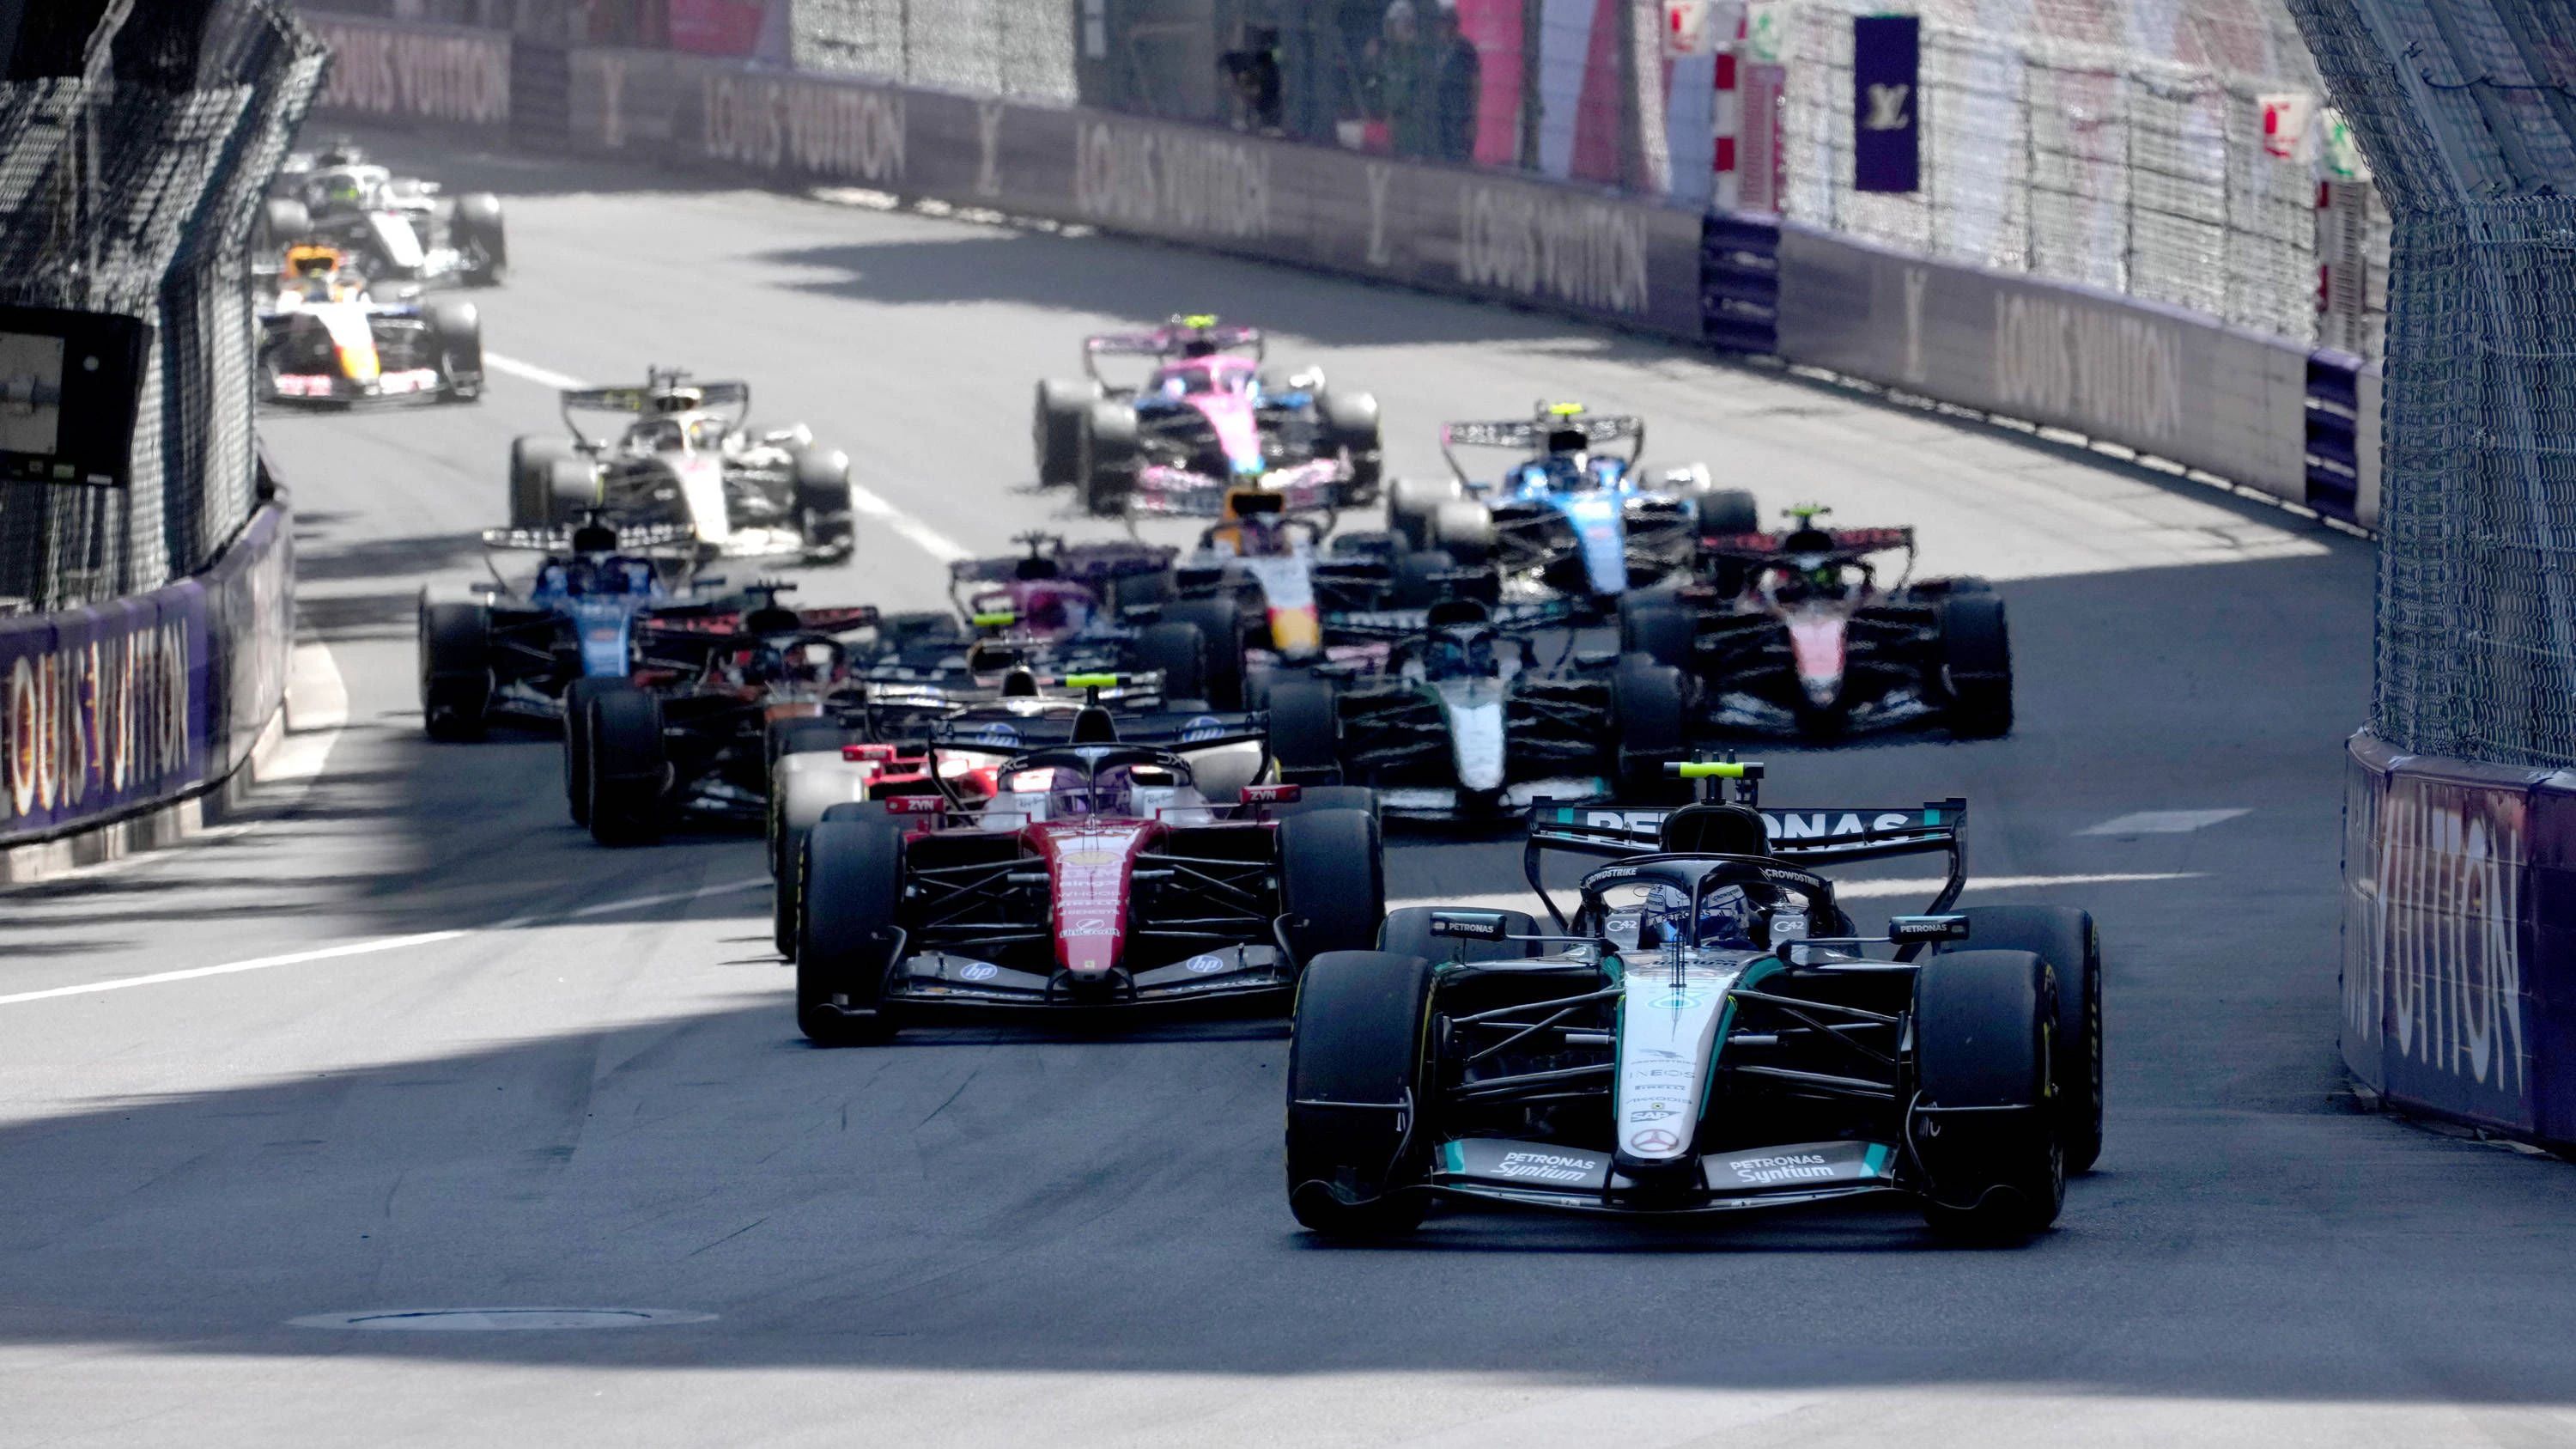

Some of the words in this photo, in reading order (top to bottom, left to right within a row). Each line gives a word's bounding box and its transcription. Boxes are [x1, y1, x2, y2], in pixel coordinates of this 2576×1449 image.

[0, 648, 85, 817] OUIS
[1251, 790, 1277, 801] ZYN
[908, 801, 935, 811] ZYN
[1587, 812, 1910, 850] PENAS
[1662, 910, 1711, 922] PETROAS
[1449, 922, 1494, 934] PETRONAS
[1607, 920, 1637, 932] G42
[1774, 921, 1804, 933] G42
[1899, 923, 1947, 934] PETRONAS
[1194, 956, 1218, 972] hp
[965, 963, 993, 980] hp
[1630, 1069, 1696, 1079] INEOS
[1631, 1111, 1670, 1121] SAP
[1504, 1152, 1596, 1170] PETRONAS
[1728, 1154, 1826, 1171] PETRONAS
[1491, 1161, 1587, 1182] Syntium
[1737, 1165, 1835, 1184] Syntium
